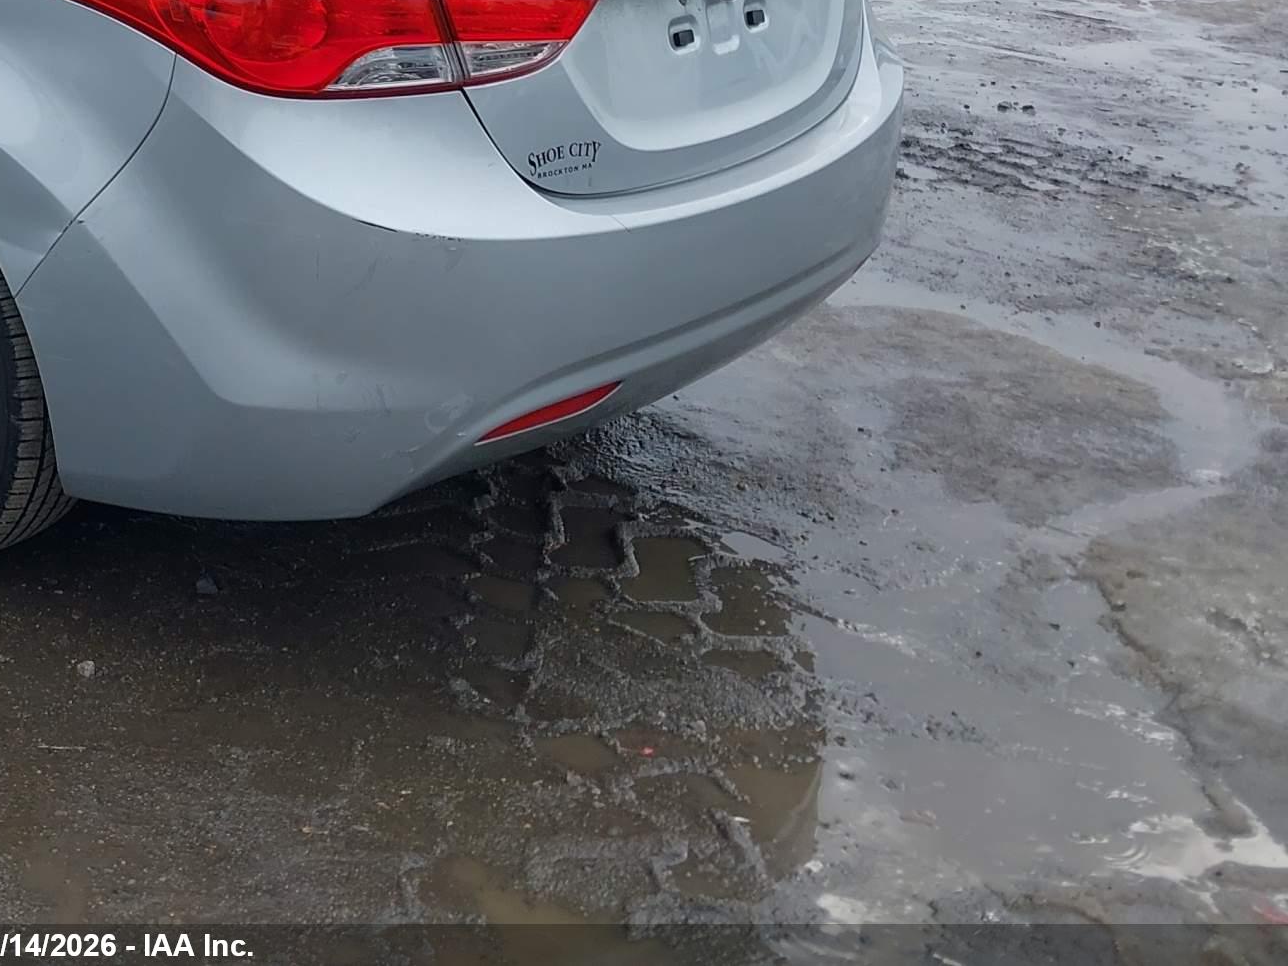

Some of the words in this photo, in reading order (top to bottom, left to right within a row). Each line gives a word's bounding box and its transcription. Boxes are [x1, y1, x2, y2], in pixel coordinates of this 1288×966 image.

[527, 145, 565, 177] SHOE
[569, 140, 602, 163] CITY
[537, 166, 579, 179] BROCKTON
[582, 162, 593, 171] MA
